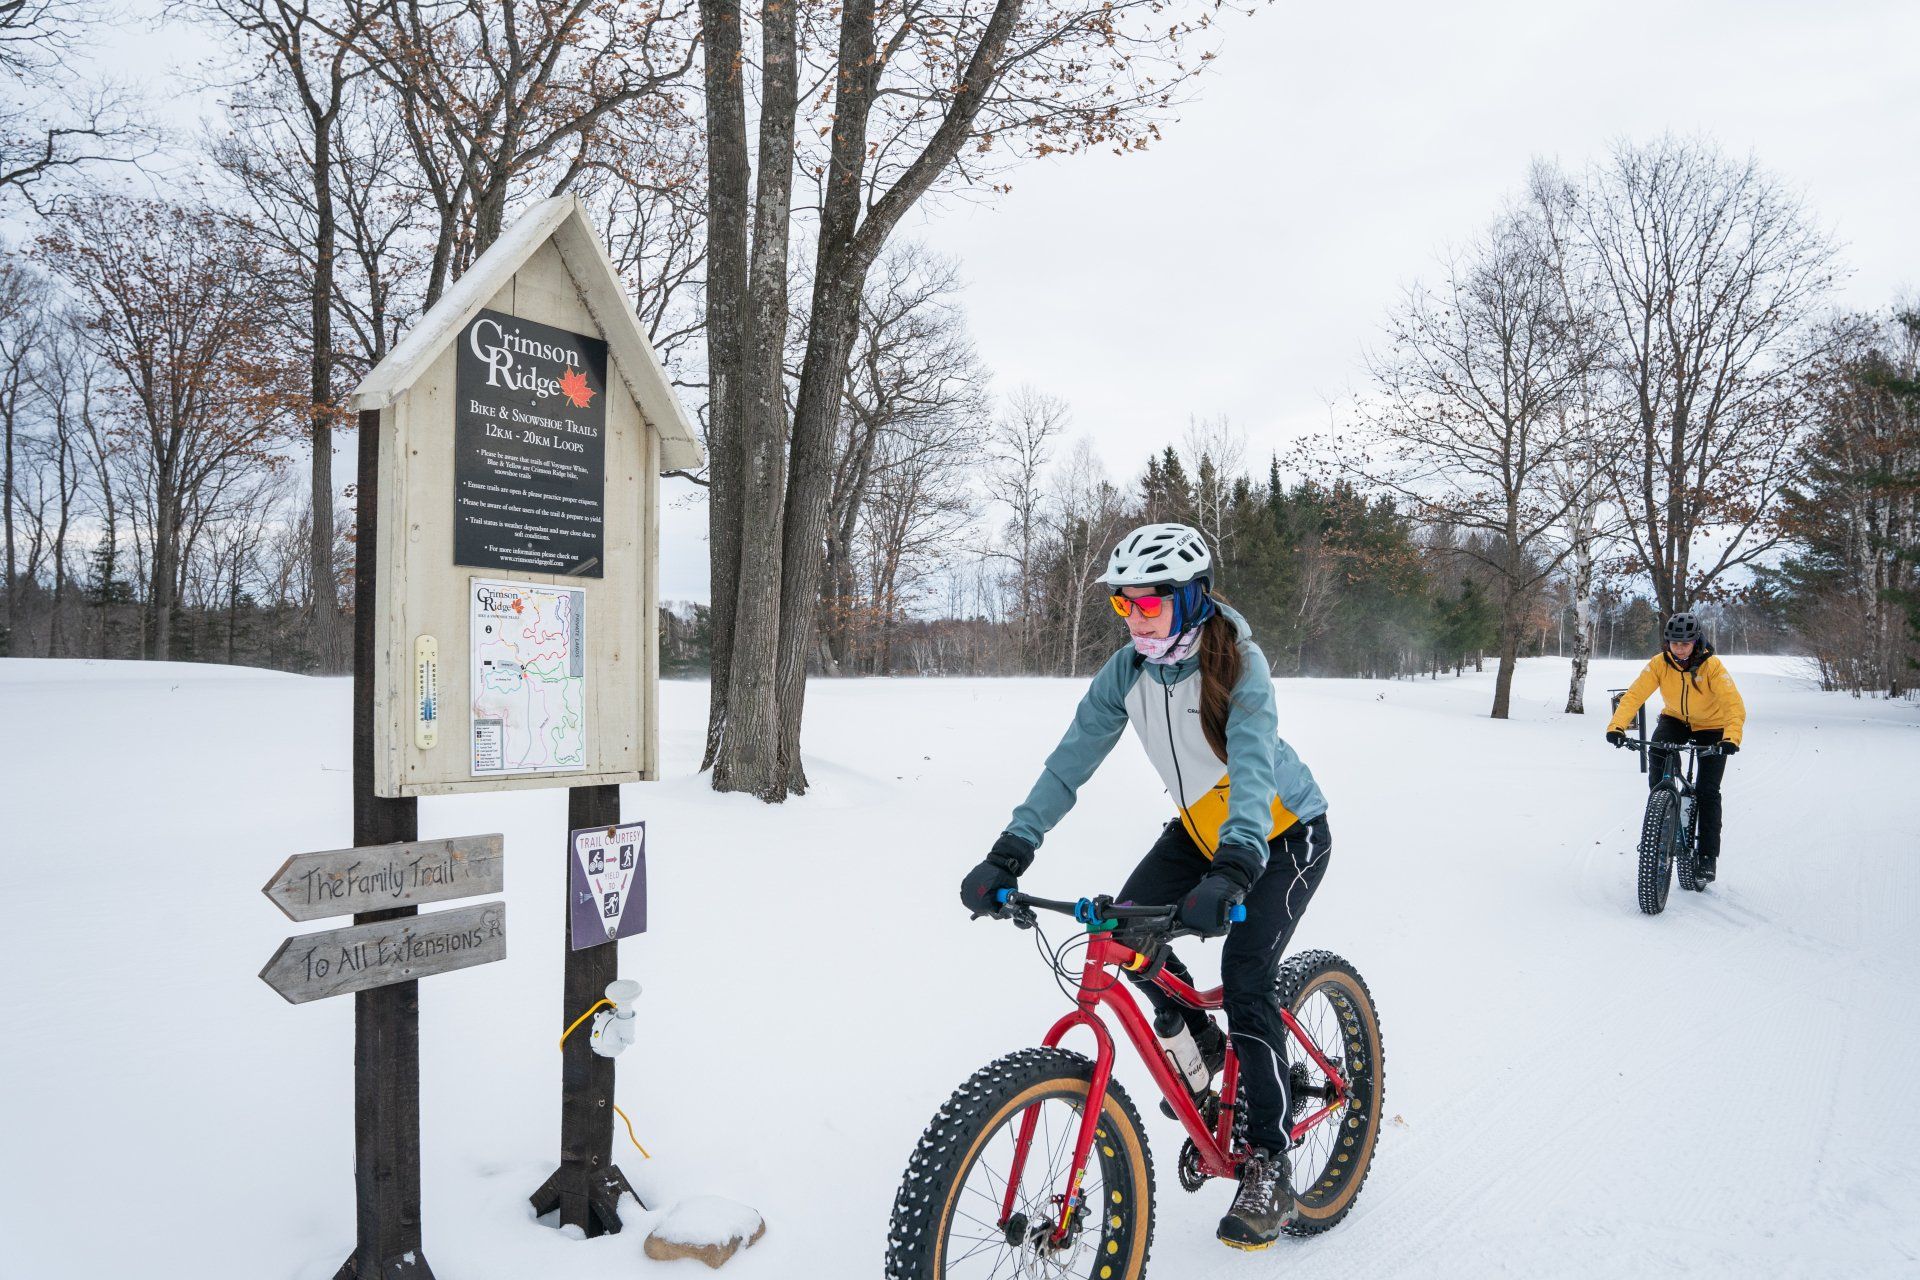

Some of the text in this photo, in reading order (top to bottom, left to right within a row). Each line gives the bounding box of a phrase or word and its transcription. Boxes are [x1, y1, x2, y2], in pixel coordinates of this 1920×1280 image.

[470, 319, 579, 367] Crimson
[485, 344, 560, 398] Ridge
[470, 400, 598, 437] BIKE & SNOWSHOE TRAILS
[486, 423, 512, 440] 12KM
[523, 431, 550, 447] 20KM
[553, 436, 584, 453] LOOPS
[481, 449, 496, 457] Please
[494, 469, 518, 477] snowshoe
[531, 466, 551, 474] Crimson
[552, 470, 566, 478] Ridge
[468, 481, 486, 489] Ensure
[463, 498, 479, 506] Please
[1177, 533, 1194, 546] GIRO
[513, 548, 540, 556] information
[477, 588, 518, 602] Crimson
[484, 597, 511, 613] Ridge
[580, 831, 640, 849] TRAIL COURTESY
[409, 856, 456, 887] Trail
[604, 871, 619, 880] YIELD
[301, 947, 330, 982] To
[338, 944, 368, 974] All
